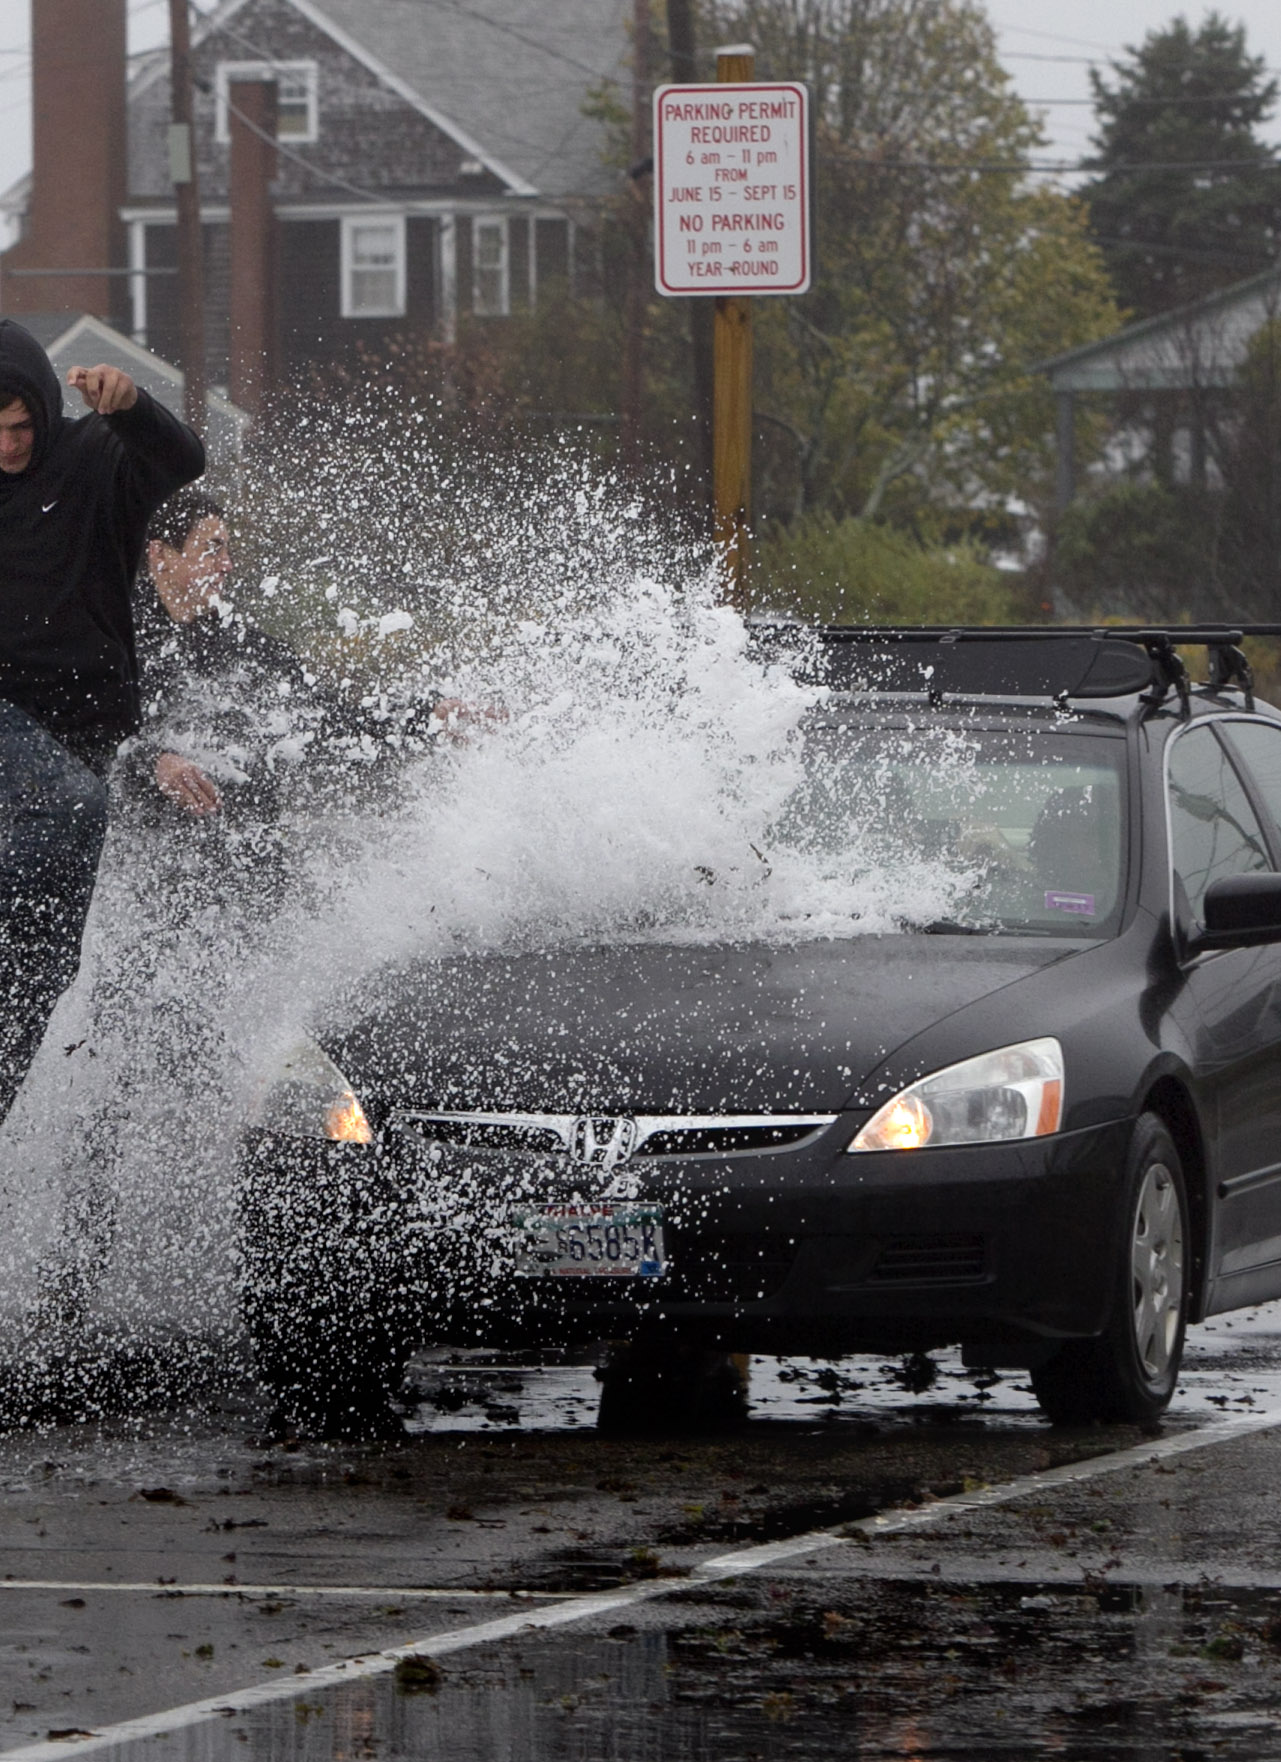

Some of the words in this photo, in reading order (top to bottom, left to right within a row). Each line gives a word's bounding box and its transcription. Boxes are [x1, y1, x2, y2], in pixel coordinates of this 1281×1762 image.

[665, 103, 733, 121] PARKING
[739, 101, 796, 119] PERMIT
[691, 125, 770, 143] REQUIRED
[686, 151, 694, 165] 6
[701, 153, 720, 164] am
[742, 149, 750, 163] 11
[757, 150, 777, 166] pm
[715, 169, 747, 181] FROM
[669, 187, 702, 202] JUNE
[709, 187, 721, 201] 15
[744, 186, 776, 200] SEPT
[784, 185, 796, 200] 15
[680, 215, 703, 232] NO
[712, 213, 784, 231] PARKING
[687, 240, 696, 254] 11
[702, 240, 721, 256] pm
[744, 239, 752, 253] 6
[758, 241, 778, 252] am
[688, 261, 779, 277] YEAR-ROUND
